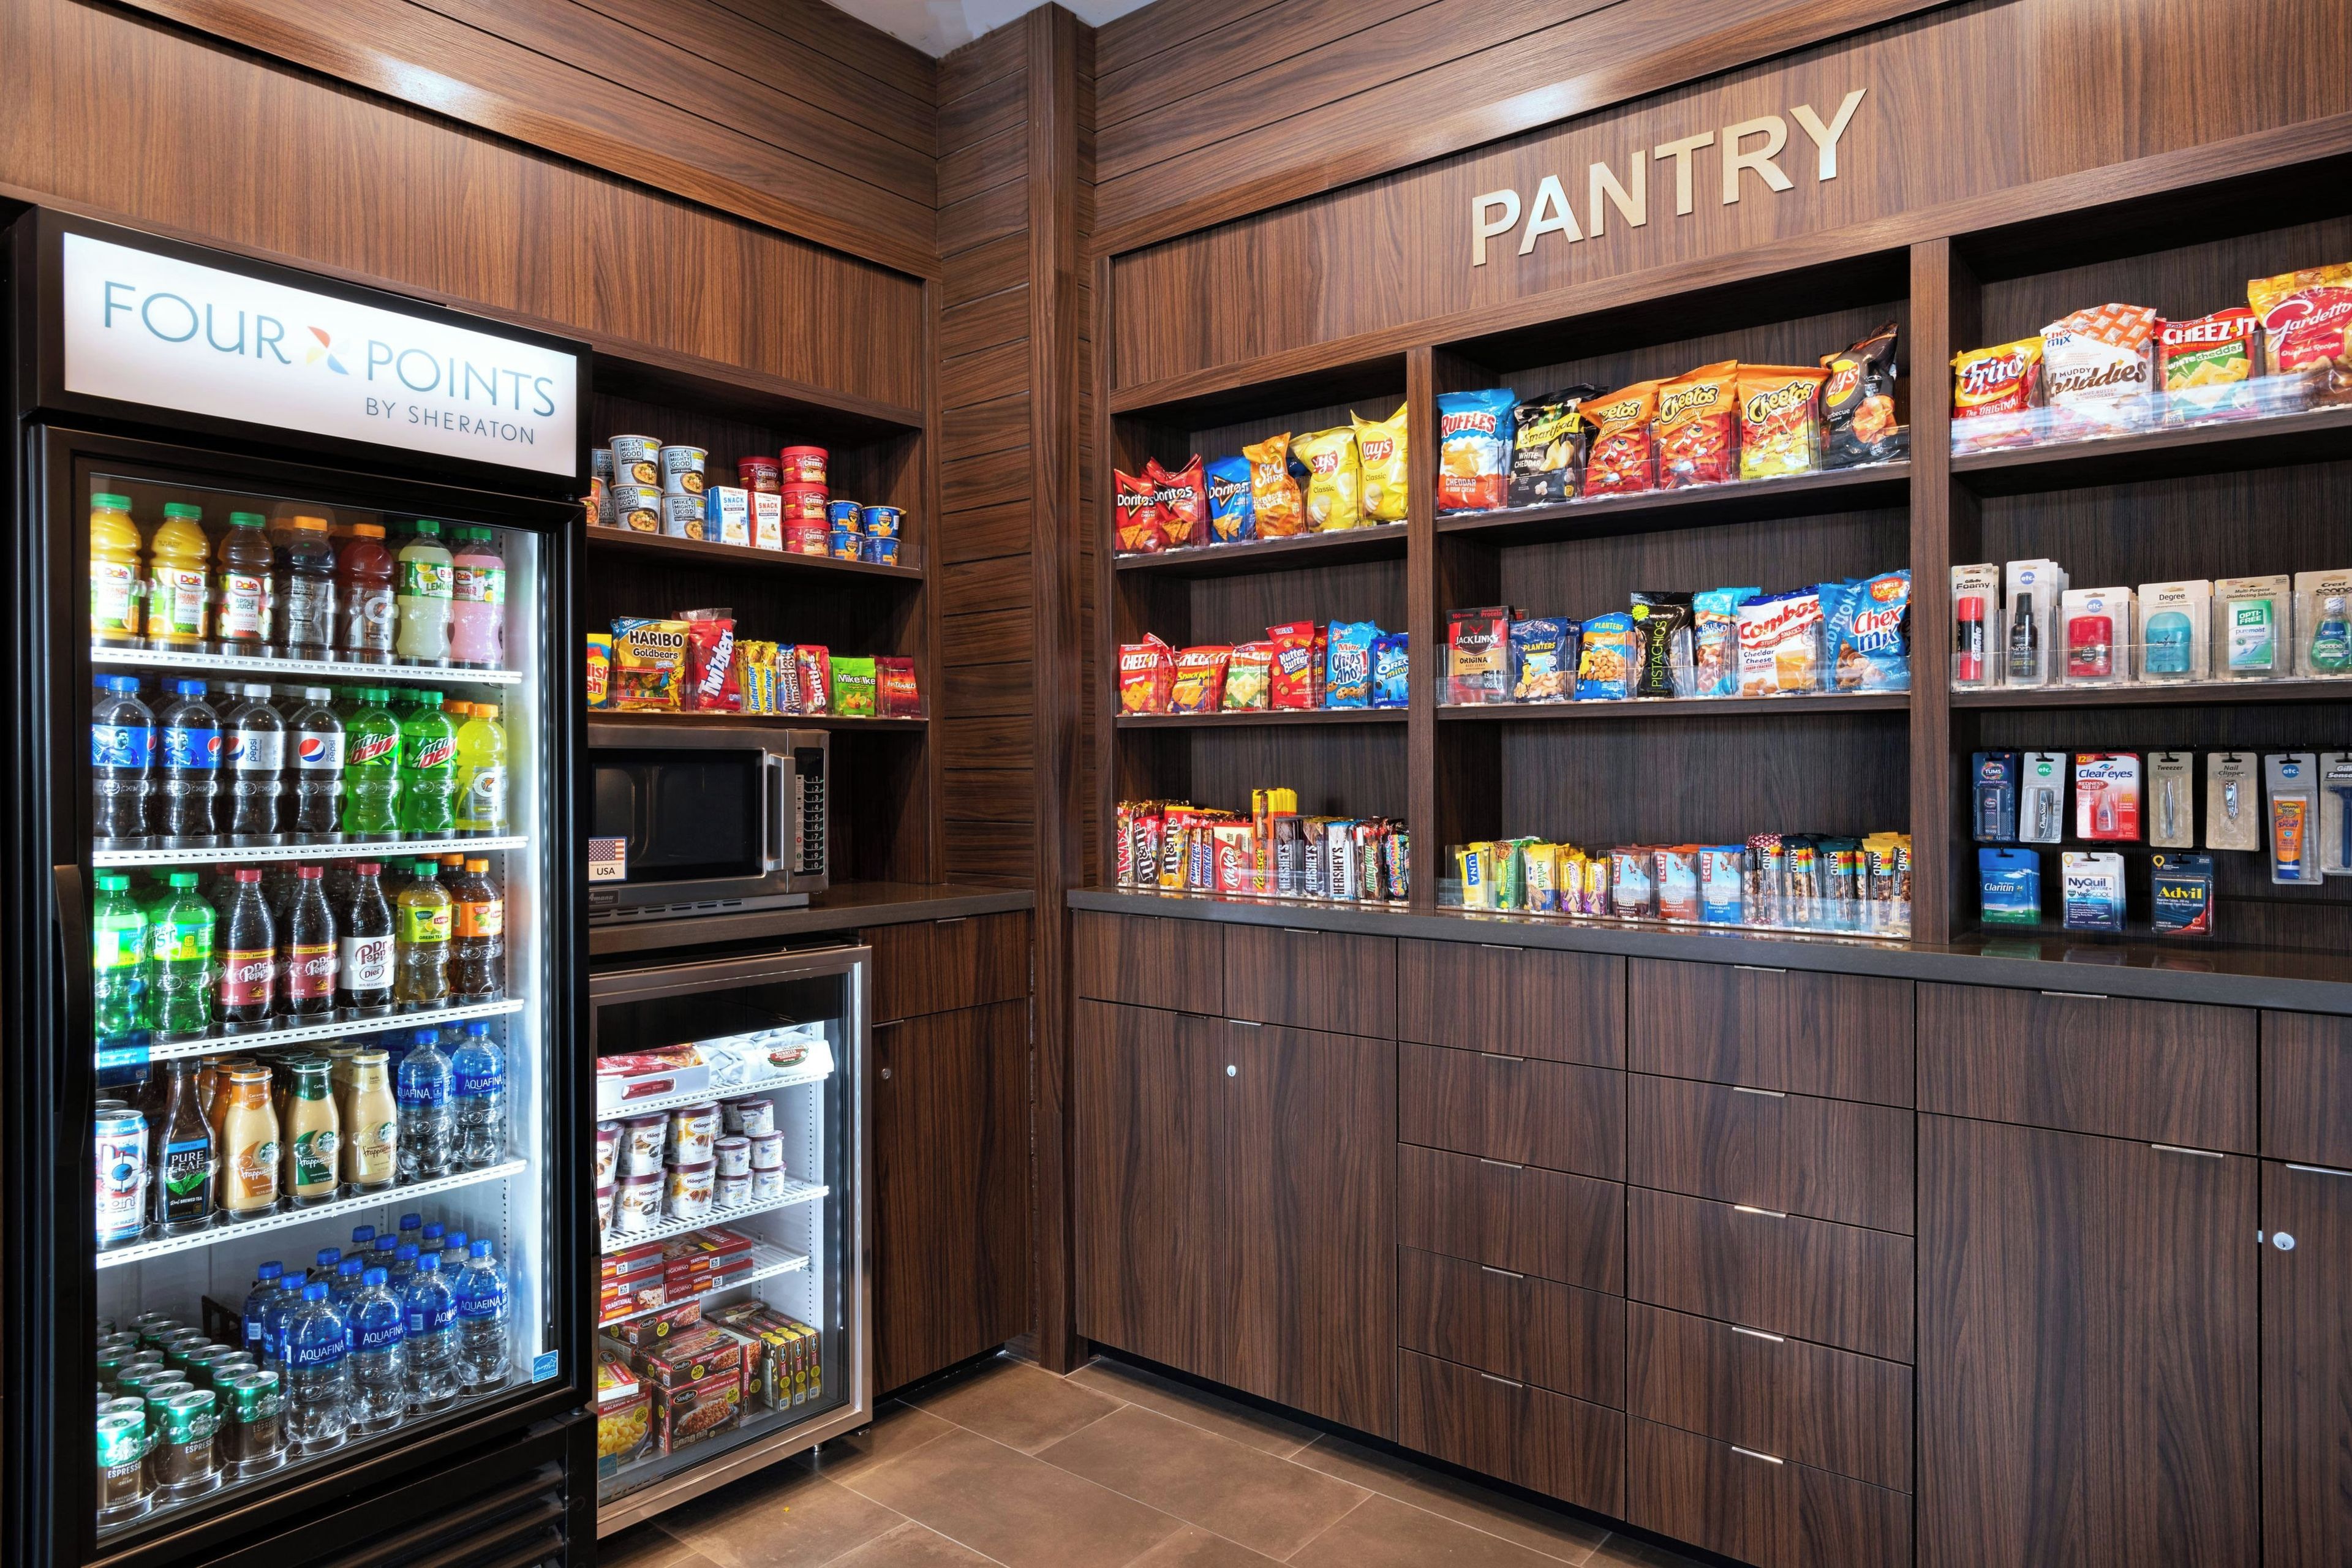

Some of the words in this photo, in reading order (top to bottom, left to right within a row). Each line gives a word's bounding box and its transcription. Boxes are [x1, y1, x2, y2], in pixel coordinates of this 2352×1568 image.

[1472, 88, 1868, 267] PANTRY
[2163, 316, 2256, 345] CHEEZ-IT
[104, 280, 292, 365] FOUR
[367, 339, 556, 417] POINTS
[2048, 334, 2071, 347] mix
[2196, 342, 2244, 361] cheddar
[1959, 352, 2026, 394] Fritos
[2059, 368, 2092, 378] MUDDY
[1660, 384, 1719, 424] Cheetos
[1747, 381, 1815, 424] Cheetos
[366, 397, 396, 419] BY
[408, 405, 535, 445] SHERATON
[1442, 412, 1496, 438] RUFFLES
[1520, 417, 1575, 445] Smartfood
[1362, 439, 1393, 461] Lay's
[1514, 459, 1542, 468] CHEDDAR
[1208, 481, 1250, 499] Doritos
[1313, 484, 1335, 494] Classic
[1446, 478, 1477, 487] CHEDDAR
[1117, 492, 1155, 507] Doritos
[1154, 486, 1193, 502] Doritos
[181, 575, 201, 585] Dole
[235, 581, 257, 591] Dole
[1740, 598, 1820, 640] Combos
[1853, 605, 1906, 633] Chex
[2239, 610, 2261, 619] OPTI-
[2240, 616, 2261, 625] FREE
[1594, 622, 1624, 631] PLANTERS
[1695, 624, 1728, 638] DIAMOND
[1702, 622, 1719, 631] BLUE
[2236, 627, 2265, 636] puremoist
[629, 630, 684, 647] HARIBO
[1455, 636, 1474, 645] JACK
[1523, 641, 1556, 652] PLANTERS
[1858, 625, 1899, 652] mix
[633, 647, 679, 660] Goldbears
[1279, 647, 1306, 663] Nutter
[1651, 620, 1667, 688] PISTACHIOS
[1743, 649, 1775, 658] Cheddar
[1746, 655, 1772, 664] Cheese
[1283, 656, 1310, 673] Butter
[1332, 654, 1360, 672] Chips
[809, 654, 826, 707] Skittles
[838, 674, 860, 684] Mike
[863, 675, 875, 685] Ike
[1385, 666, 1408, 679] mini
[748, 665, 760, 710] Butterfinger
[2078, 769, 2106, 778] Clear
[2108, 771, 2133, 780] eyes
[1117, 826, 1132, 880] TWIX
[1790, 850, 1799, 873] KIND
[597, 867, 616, 876] USA
[1203, 844, 1213, 888] SNICKERS
[1253, 847, 1265, 890] Reese's
[1278, 843, 1291, 890] HERSHEY'S
[1305, 844, 1317, 892] HERSHEY'S
[1332, 848, 1345, 894] HERSHEY'S
[1468, 853, 1480, 883] LUNA
[1830, 852, 1838, 876] KIND
[1873, 852, 1882, 876] KIND
[1537, 860, 1549, 889] belVita
[1985, 883, 2014, 892] Claritin
[2068, 878, 2106, 889] NyQuil
[2157, 886, 2202, 899] Advil
[373, 940, 388, 951] Dr
[365, 969, 380, 978] Diet
[464, 1075, 503, 1091] AQUAFINA
[172, 1151, 203, 1164] PURE
[460, 1295, 502, 1313] AQUAFINA
[605, 1297, 633, 1311] TRADITIONAL
[363, 1323, 404, 1345] AQUAFINA
[299, 1340, 344, 1363] AQUAFINA
[676, 1391, 696, 1403] Stouffer's
[108, 1461, 141, 1479] ESPRESSO
